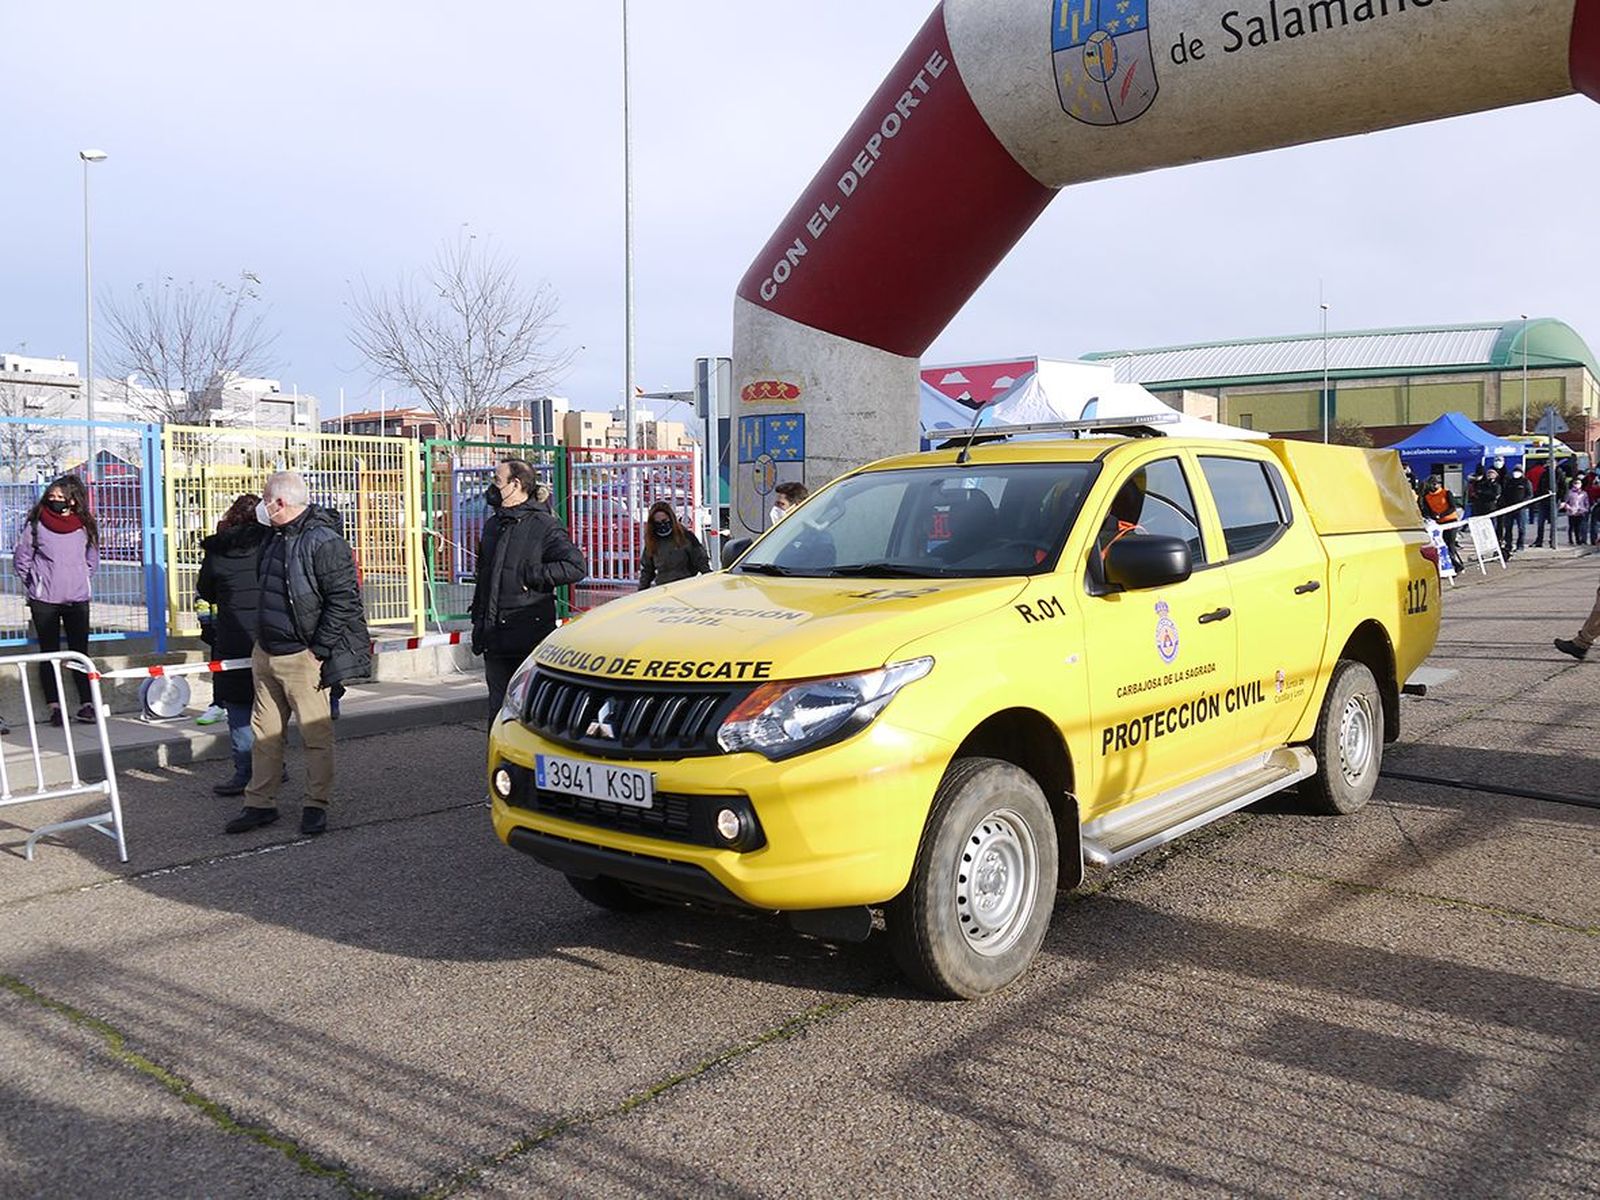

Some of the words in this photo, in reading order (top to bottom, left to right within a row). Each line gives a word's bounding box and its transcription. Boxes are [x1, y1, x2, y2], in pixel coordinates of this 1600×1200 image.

[1170, 32, 1206, 65] de
[1220, 0, 1450, 53] Salama
[759, 237, 809, 302] CON
[806, 202, 841, 240] EL
[837, 50, 949, 198] DEPORTE
[1014, 595, 1066, 623] R.01
[1408, 578, 1427, 615] 112
[658, 615, 724, 627] CIVIL
[605, 658, 640, 676] DE
[642, 660, 773, 679] RESCATE
[1116, 678, 1162, 698] CARBAJOSA
[1163, 674, 1173, 686] DE
[1174, 671, 1184, 683] LA
[1185, 662, 1216, 680] SAGRADA
[1101, 691, 1220, 756] PROTECCIÓN
[1225, 680, 1265, 714] CIVIL
[549, 761, 593, 794] 3941
[607, 769, 646, 802] KSD
